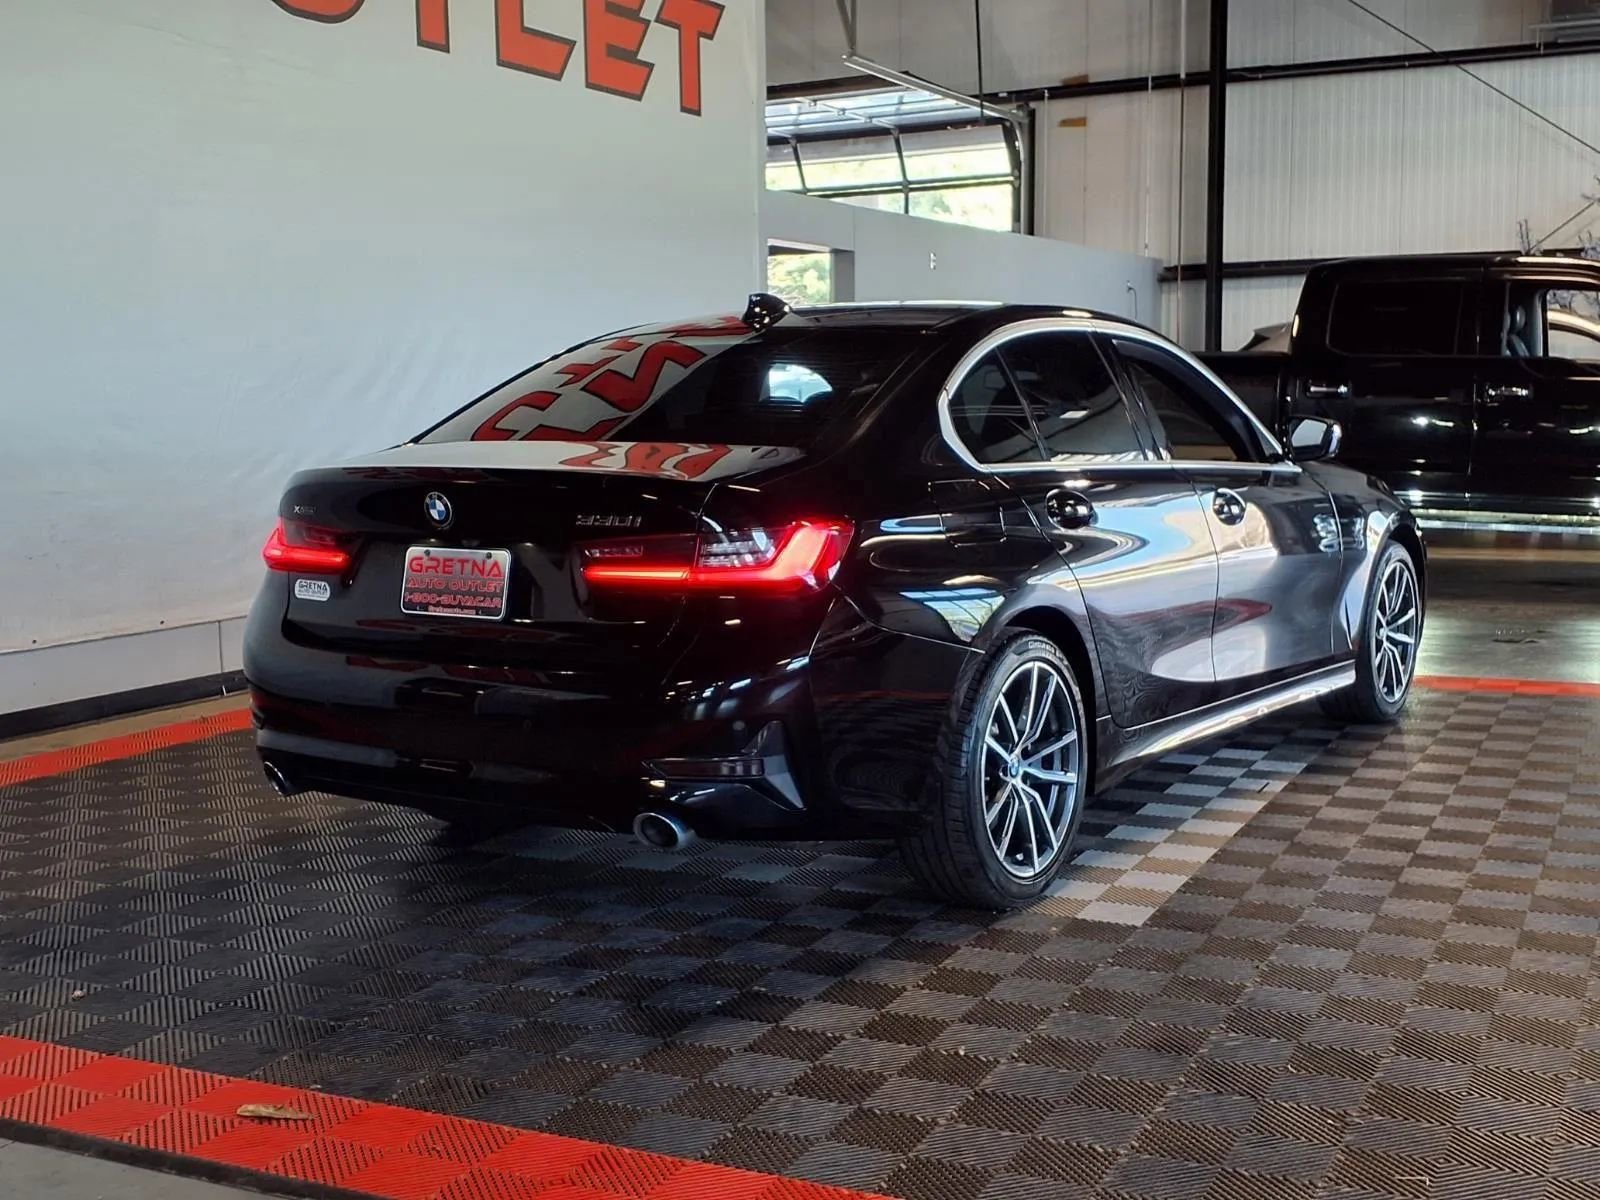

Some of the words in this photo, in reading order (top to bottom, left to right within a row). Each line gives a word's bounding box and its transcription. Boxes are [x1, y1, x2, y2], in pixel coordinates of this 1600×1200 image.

[408, 557, 504, 577] GRETNA
[299, 581, 328, 592] GRETNA
[406, 577, 446, 589] AUTO
[448, 579, 503, 593] OUTLET
